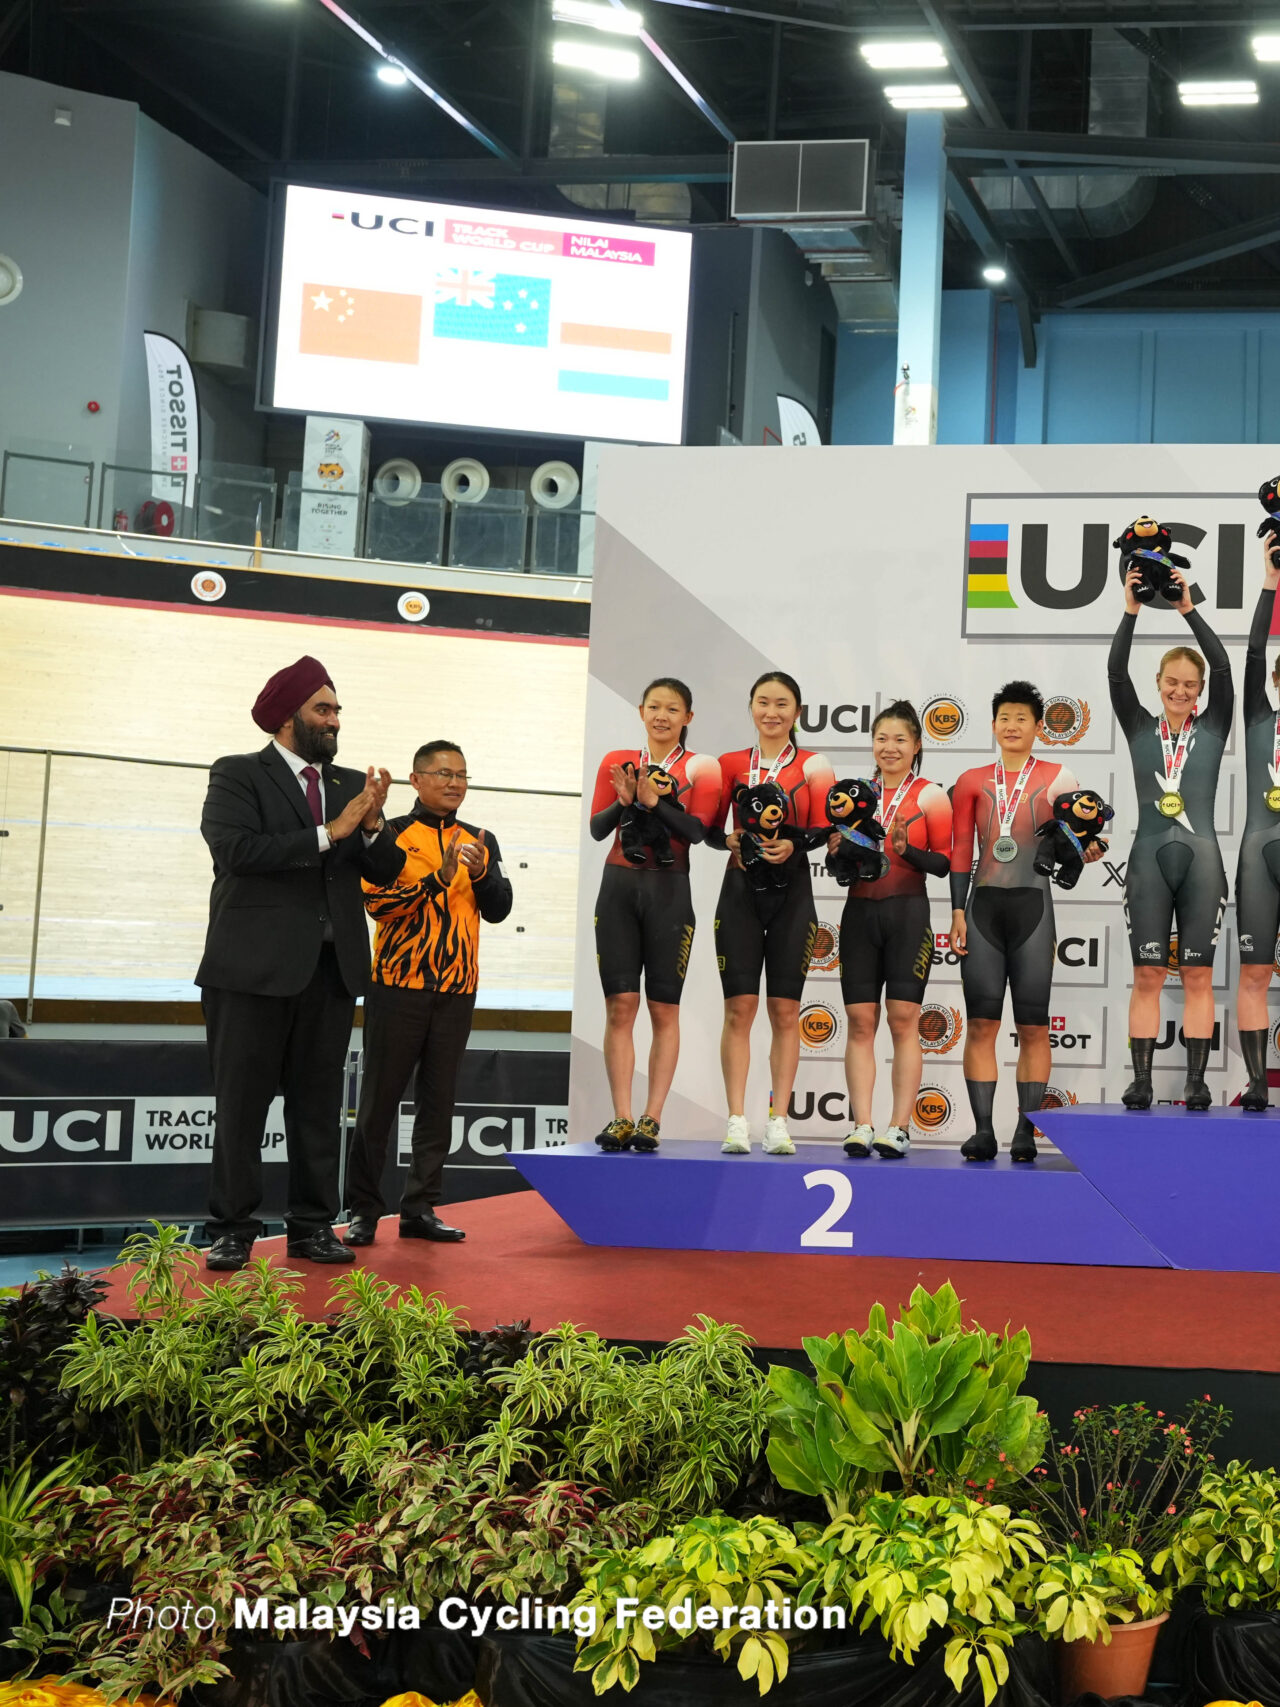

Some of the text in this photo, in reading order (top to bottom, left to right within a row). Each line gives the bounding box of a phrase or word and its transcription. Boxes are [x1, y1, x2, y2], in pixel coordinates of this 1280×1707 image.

[351, 212, 434, 237] UCI
[452, 223, 509, 238] TRACK
[452, 233, 555, 253] WORLD CUP
[570, 236, 608, 249] NILAI
[570, 246, 643, 263] MALAYSIA
[311, 508, 348, 516] TOGETHER
[317, 502, 342, 510] RISING
[1021, 522, 1245, 610] UCI
[800, 704, 871, 733] UCI
[934, 714, 957, 725] KBS
[676, 923, 694, 979] CHINA
[800, 921, 818, 976] CHINA
[912, 927, 934, 980] CHINA
[1057, 937, 1098, 967] CI
[811, 955, 831, 964] ALAYSIA
[808, 1021, 830, 1032] KBS
[1151, 1020, 1220, 1051] UI
[1010, 1033, 1091, 1049] TSOT
[921, 1104, 944, 1114] KBS
[146, 1110, 216, 1127] TRACK
[0, 1109, 119, 1153] UCI
[145, 1132, 285, 1150] WORL UP
[801, 1170, 853, 1248] 2
